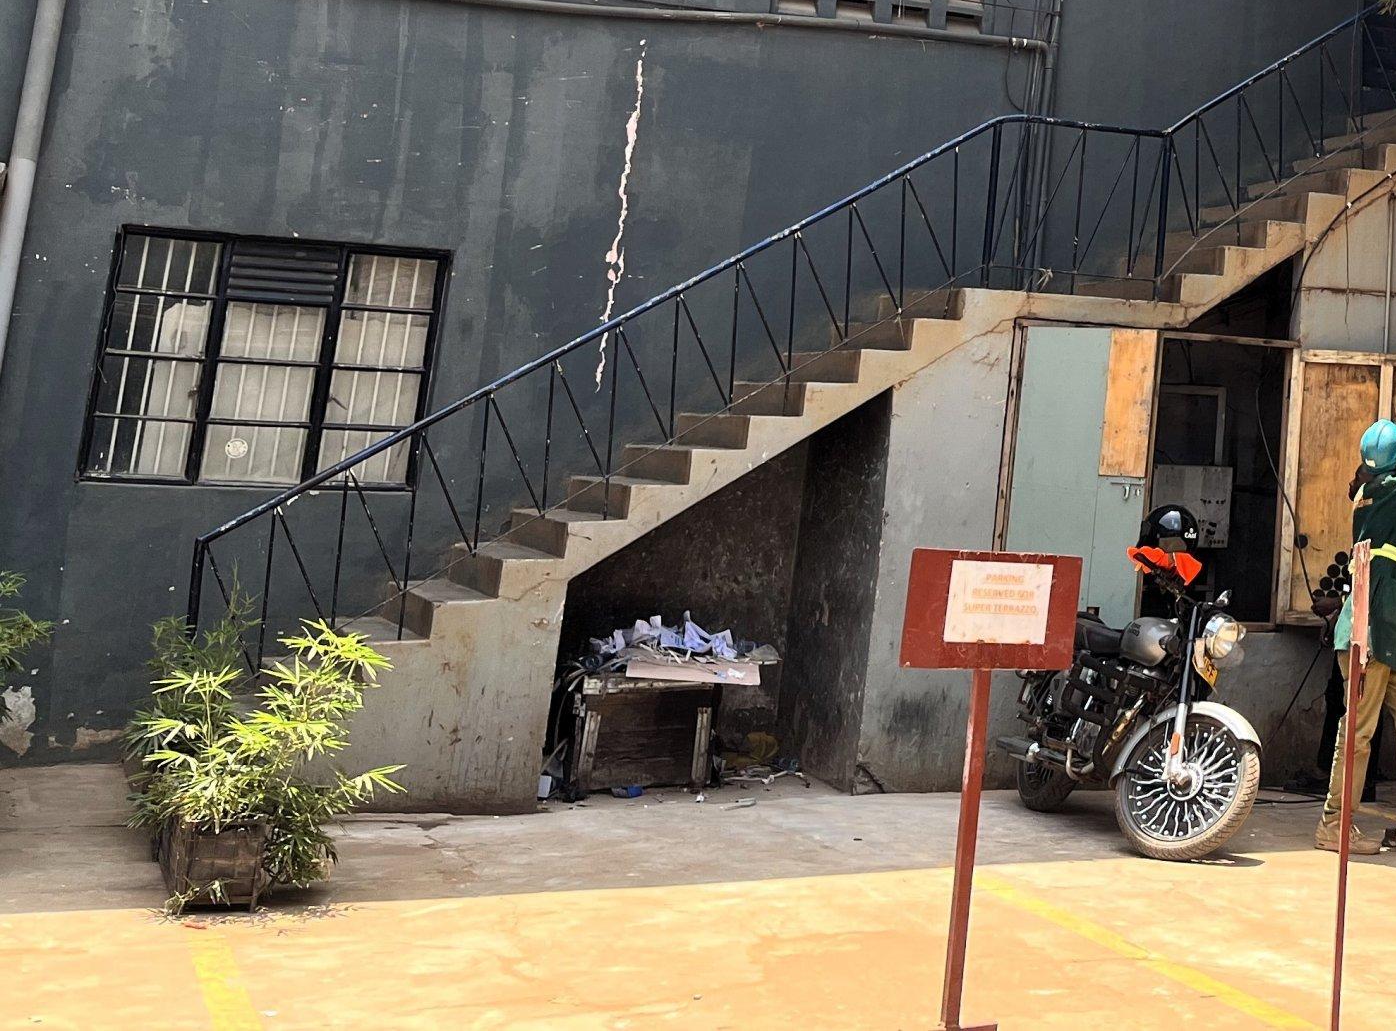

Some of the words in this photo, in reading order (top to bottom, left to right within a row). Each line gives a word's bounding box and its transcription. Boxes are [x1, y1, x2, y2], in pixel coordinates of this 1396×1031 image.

[986, 574, 1025, 583] PARKING
[972, 588, 1016, 598] RESERVED
[964, 602, 991, 612] SUPER
